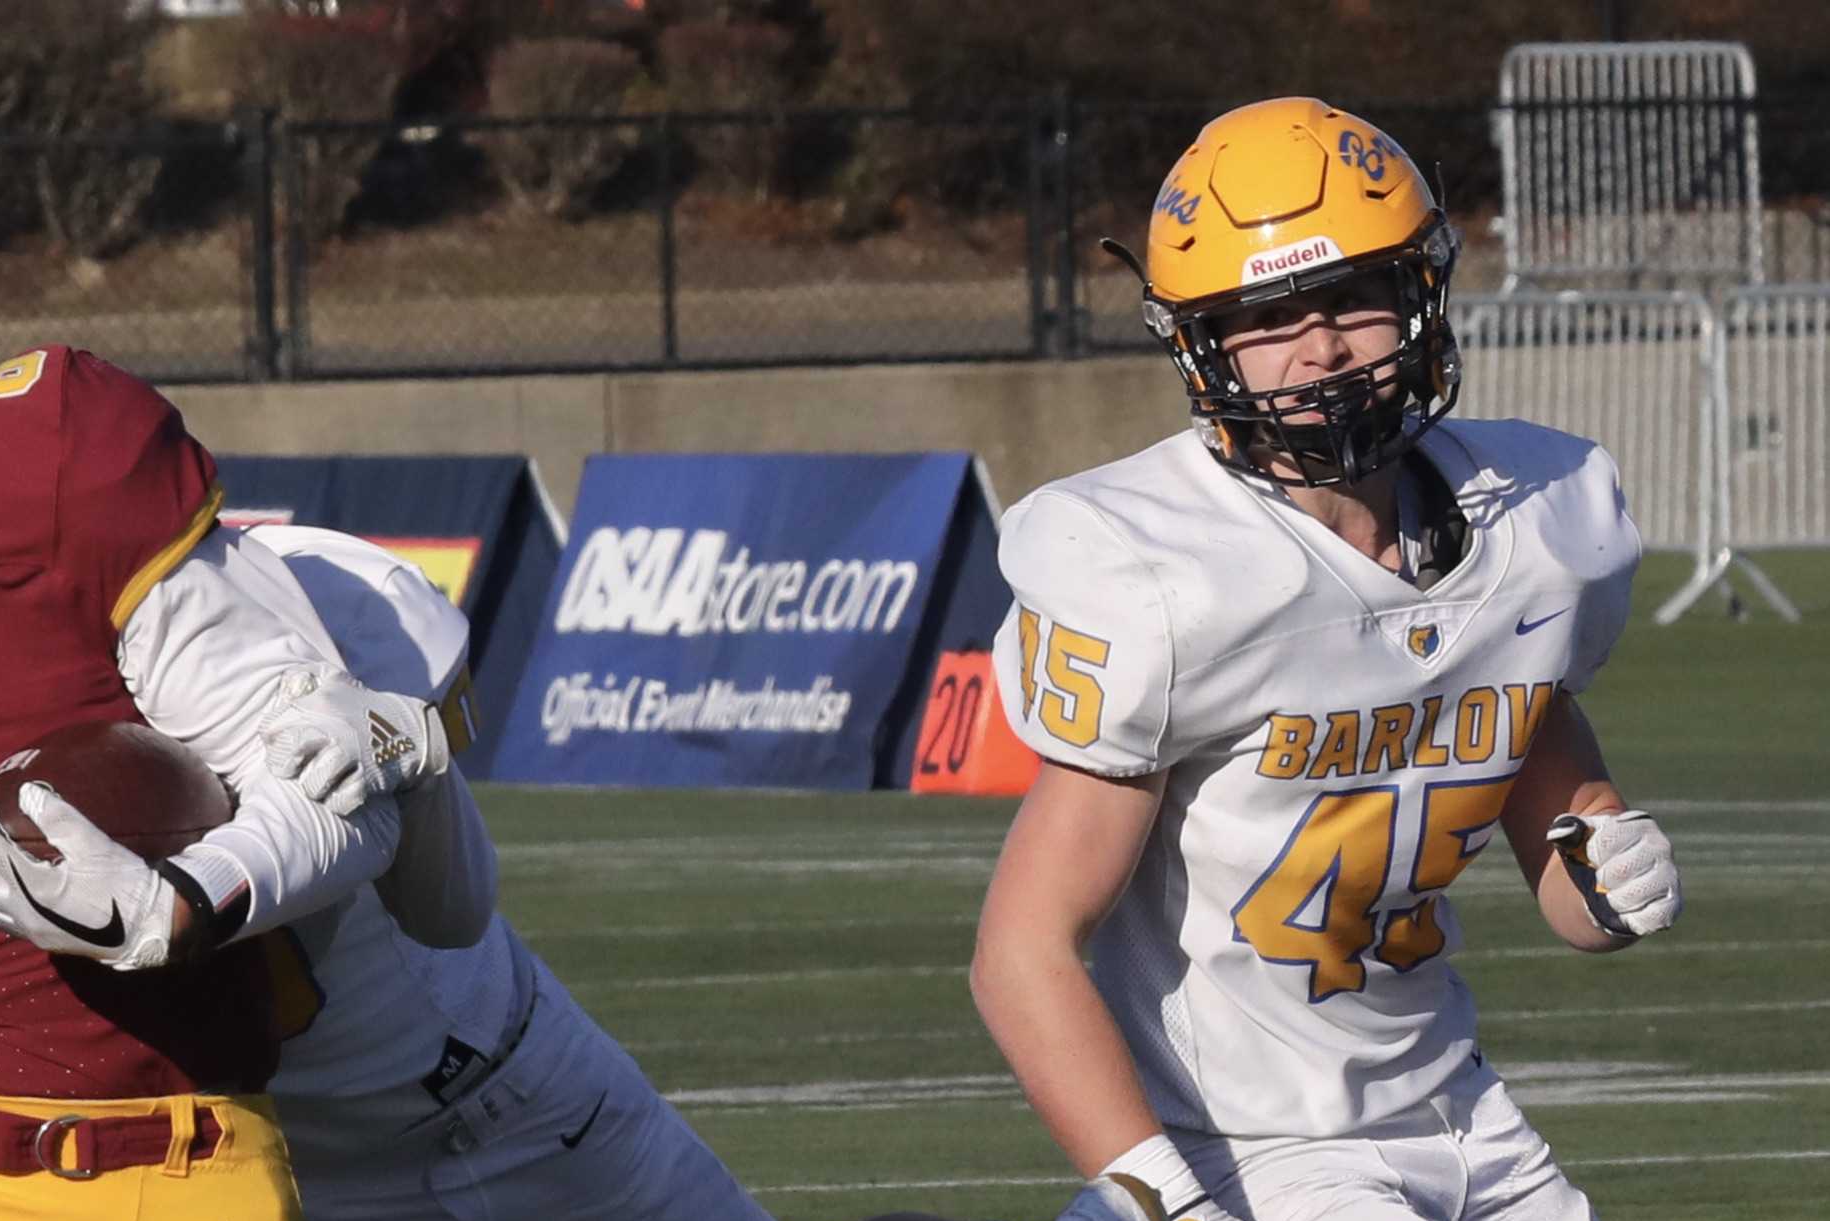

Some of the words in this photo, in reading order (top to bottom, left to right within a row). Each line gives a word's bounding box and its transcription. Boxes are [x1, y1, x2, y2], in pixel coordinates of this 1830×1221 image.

[1251, 241, 1328, 276] Riddell
[921, 674, 982, 776] 20
[1230, 773, 1517, 1004] 45
